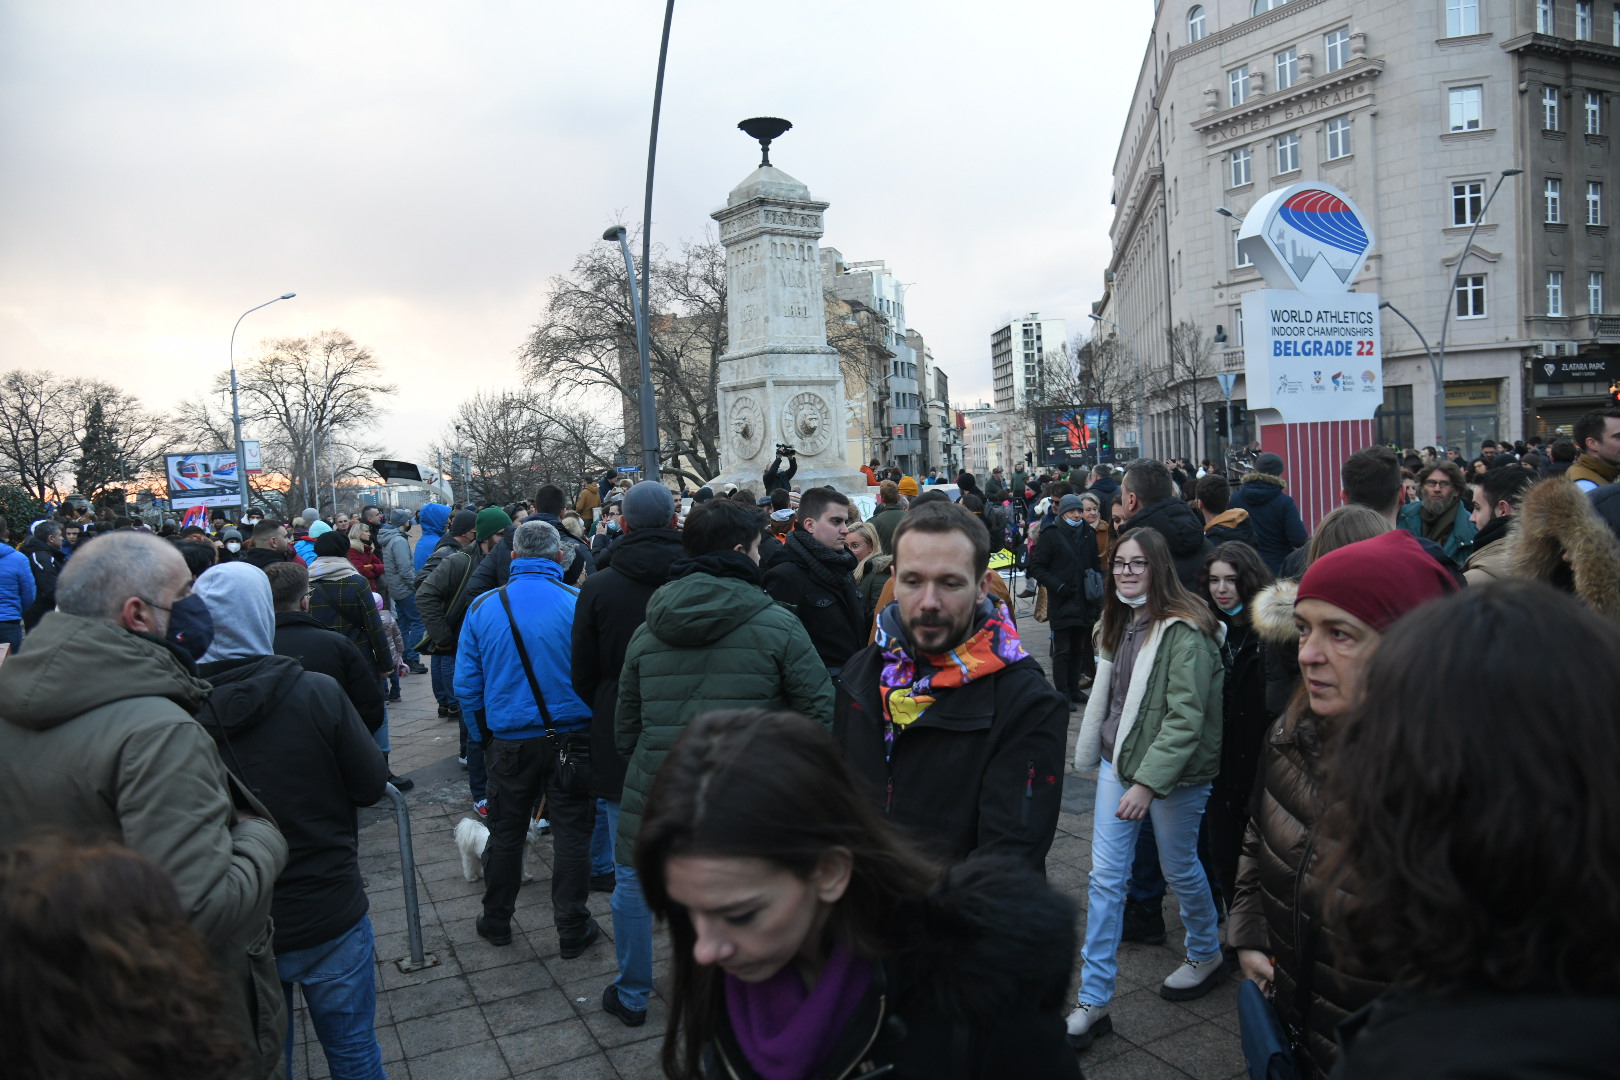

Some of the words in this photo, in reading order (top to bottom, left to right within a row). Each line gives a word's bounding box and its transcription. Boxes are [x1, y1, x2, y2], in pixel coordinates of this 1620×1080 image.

[1220, 115, 1271, 140] ХОТЕЛ
[1285, 87, 1354, 120] БАЛКАН
[1271, 309, 1313, 323] WORLD
[1316, 311, 1374, 324] ATHLETICS
[1271, 326, 1305, 337] INDOOR
[1307, 327, 1374, 337] CHAMPIONSHIPS
[1273, 340, 1353, 356] BELGRADE
[1356, 340, 1374, 356] 22
[1561, 363, 1588, 371] ZLATARA
